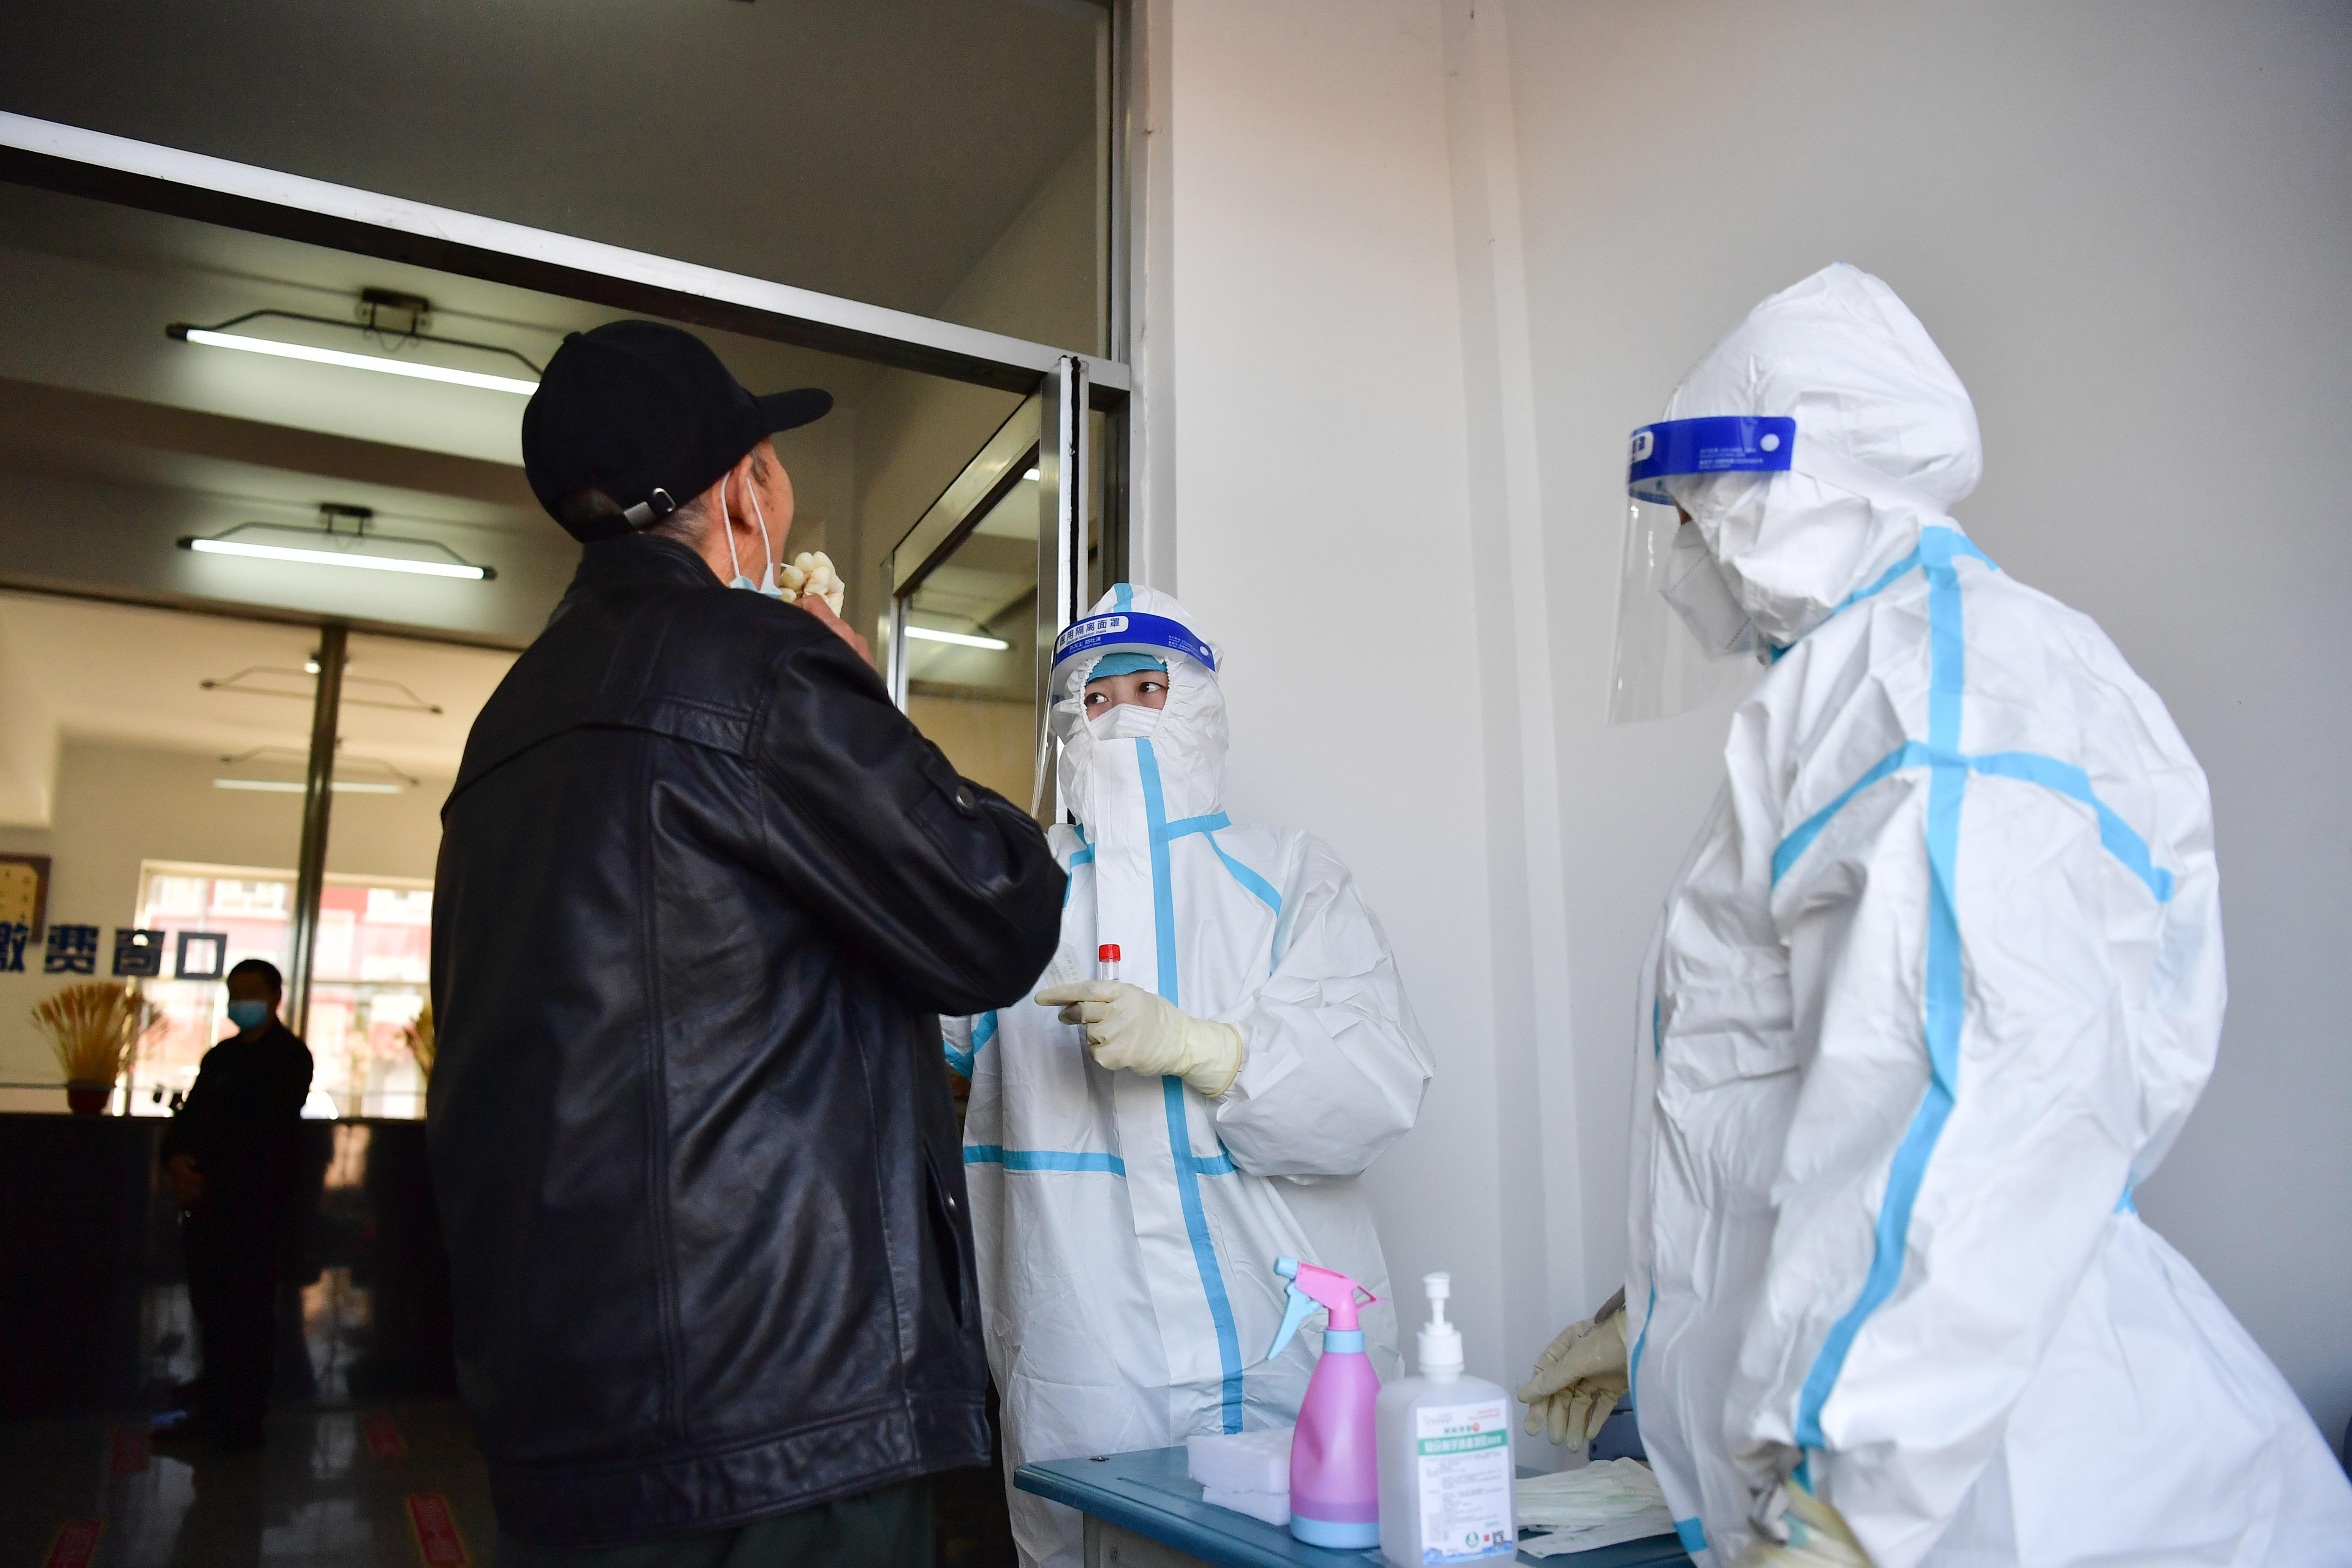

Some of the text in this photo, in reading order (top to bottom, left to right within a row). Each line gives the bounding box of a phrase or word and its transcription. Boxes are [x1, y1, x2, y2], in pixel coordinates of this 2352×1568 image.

[1060, 618, 1120, 646] 医用隔离面罩
